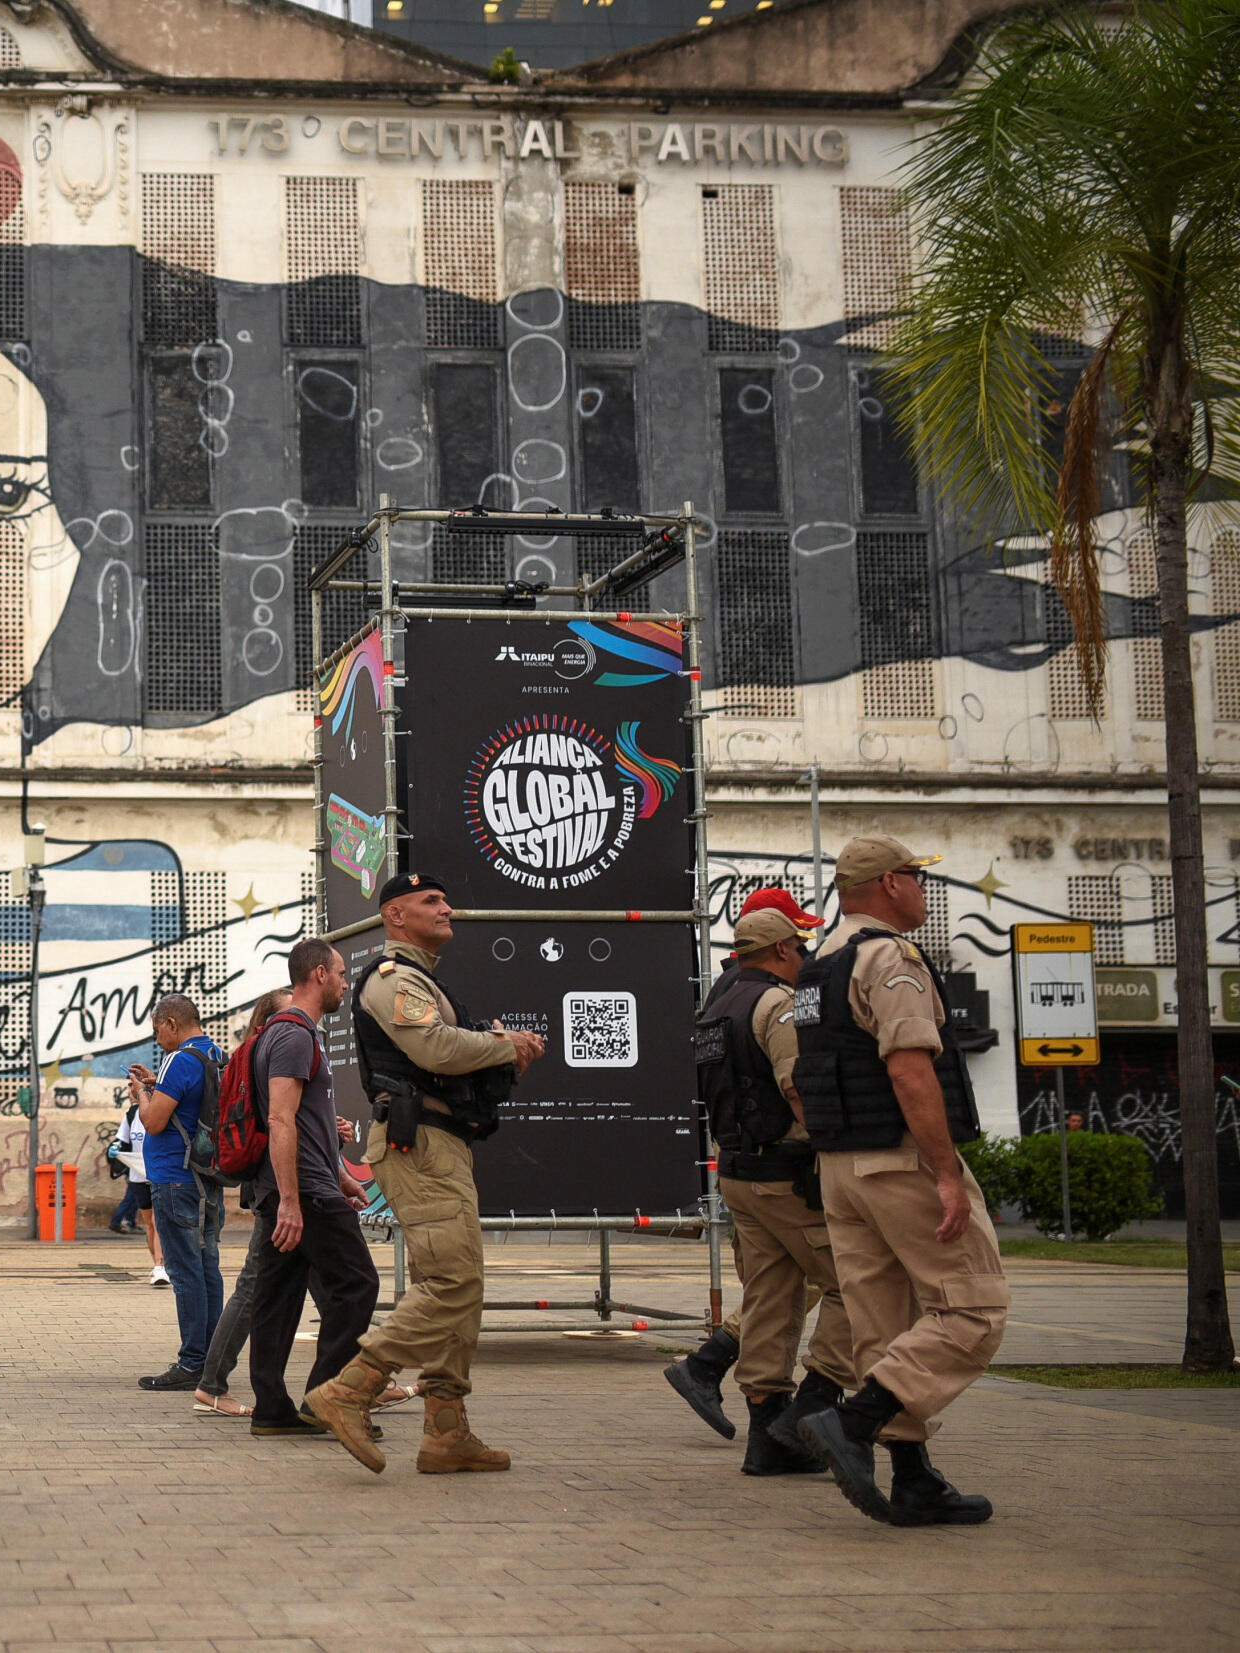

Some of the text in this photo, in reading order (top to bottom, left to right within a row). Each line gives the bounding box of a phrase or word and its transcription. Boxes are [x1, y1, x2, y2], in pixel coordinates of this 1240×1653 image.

[209, 113, 851, 168] 173 CENTRAL PARKING
[521, 653, 555, 662] ITAIPU
[521, 686, 570, 694] APRESENTA
[493, 733, 603, 775] ALIANÇA
[482, 769, 616, 837] GLOBAL
[492, 785, 636, 890] CONTRA A FOME E A POBREZA
[495, 811, 609, 869] FESTIVAL
[1009, 836, 1172, 861] 173 CENTR
[1028, 933, 1076, 944] Pedestre
[794, 986, 821, 1007] GUARDA
[1096, 983, 1151, 997] TRADA
[46, 962, 246, 1051] Amor
[501, 1012, 548, 1021] ACESSE A
[794, 1004, 821, 1022] MUNICIPAL
